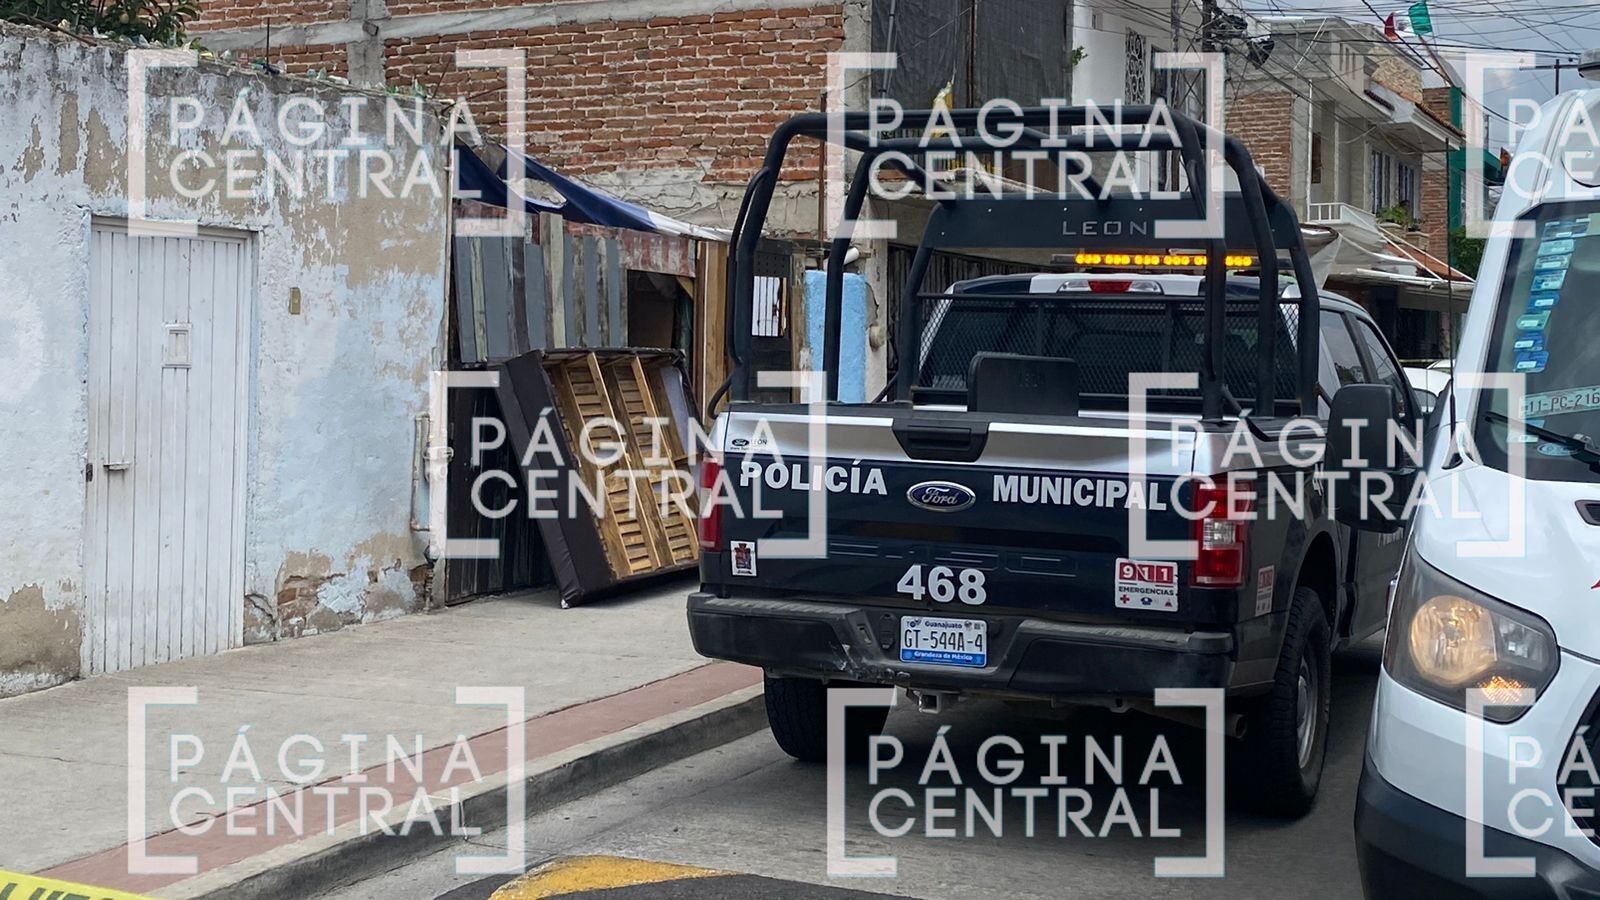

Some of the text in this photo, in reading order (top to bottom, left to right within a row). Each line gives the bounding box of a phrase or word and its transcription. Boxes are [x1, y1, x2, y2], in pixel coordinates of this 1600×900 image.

[1062, 220, 1148, 236] LEON
[739, 459, 1168, 511] POLICÍA MUNICIPAL
[896, 563, 987, 606] 468
[1118, 586, 1175, 596] EMERGENCIAS
[924, 620, 963, 630] Guanajuato
[904, 629, 983, 653] GT-544A-4
[913, 651, 942, 659] Grandeza
[951, 653, 974, 661] México
